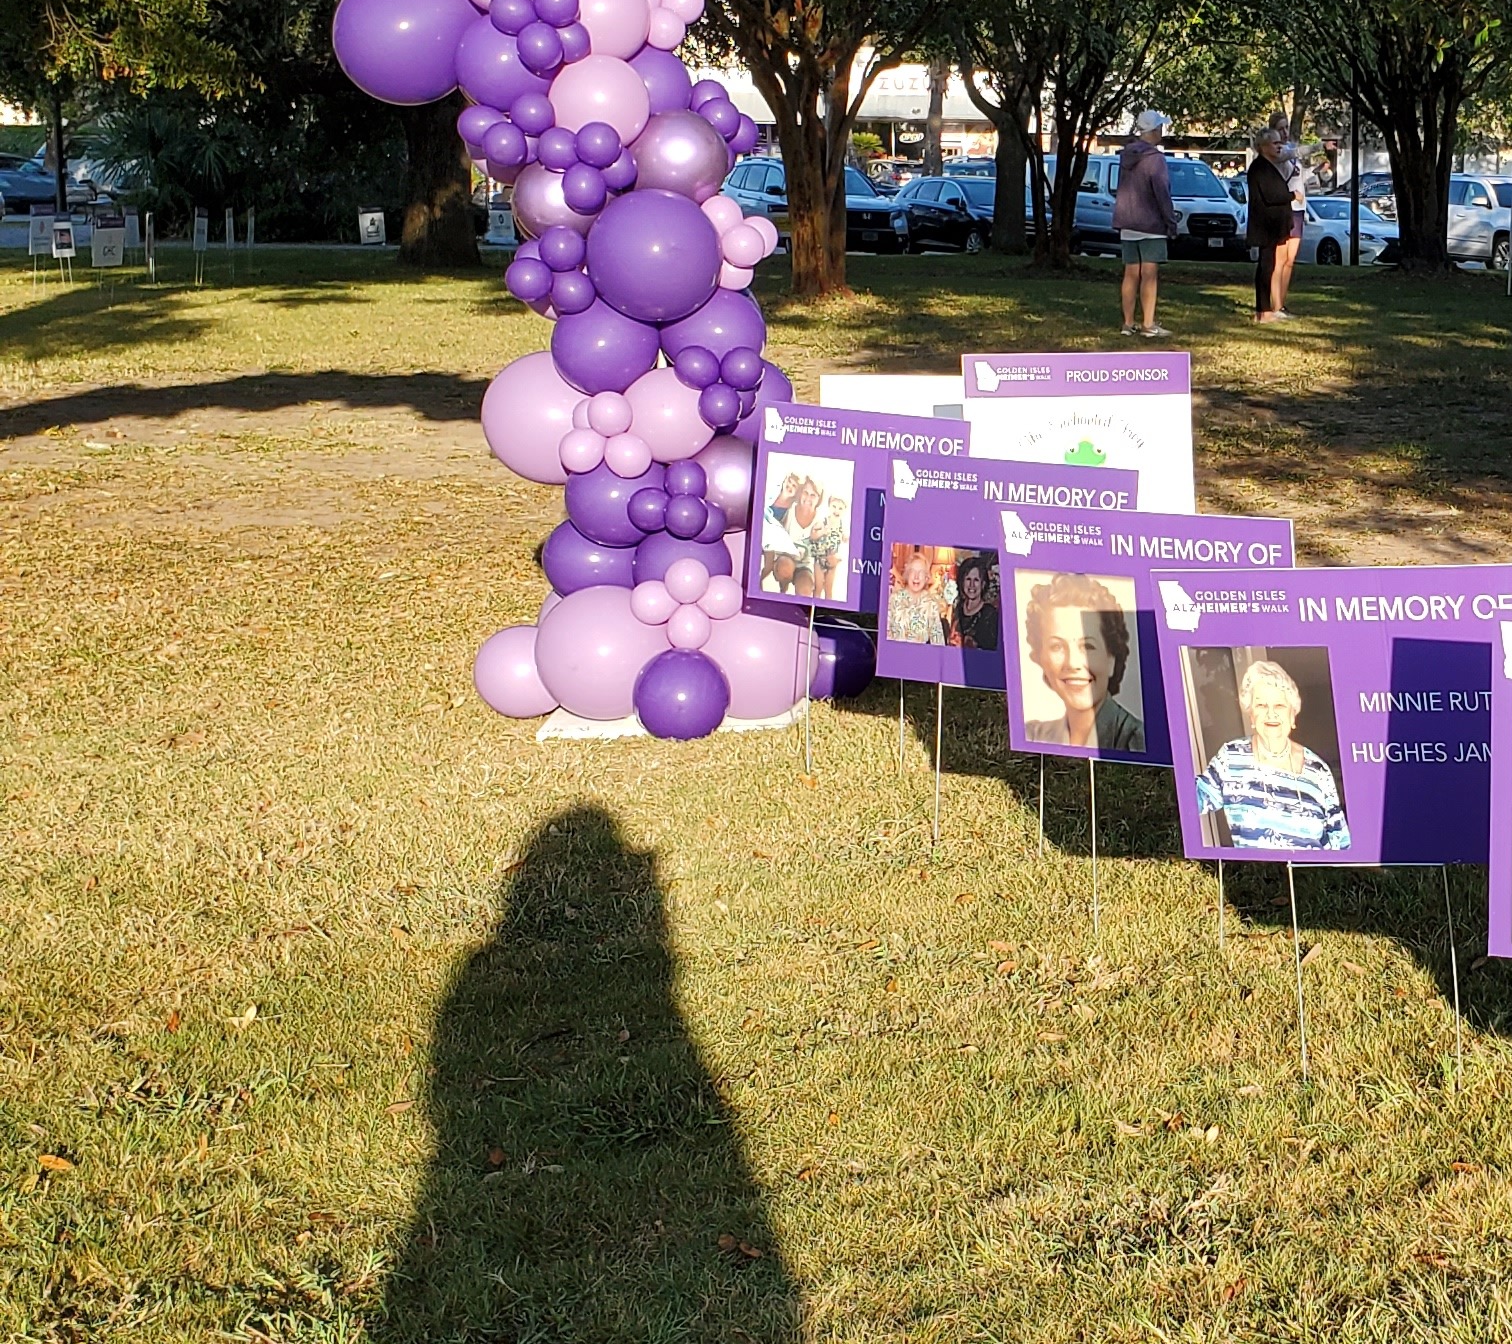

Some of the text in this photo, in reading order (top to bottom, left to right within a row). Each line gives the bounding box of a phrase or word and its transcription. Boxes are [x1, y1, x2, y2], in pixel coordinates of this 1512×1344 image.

[1066, 369, 1169, 382] PROUD SPONSOR
[784, 416, 837, 429] GOLDEN ISLES
[841, 427, 964, 455] IN MEMORY OF
[916, 469, 978, 482] GOLDEN ISLES
[984, 481, 1129, 509] IN MEMORY OF
[1029, 521, 1101, 536] GOLDEN ISLES
[1012, 531, 1103, 546] ALZHEIMER'S WALK
[1110, 534, 1282, 565] IN MEMORY OF
[1195, 590, 1286, 601] GOLDEN ISLES
[1173, 602, 1290, 614] ALZHEIMER'S WALK
[1298, 597, 1328, 622] IN
[1336, 595, 1466, 622] MEMORY
[1359, 691, 1443, 713] MINNIE
[1351, 742, 1448, 763] HUGHES
